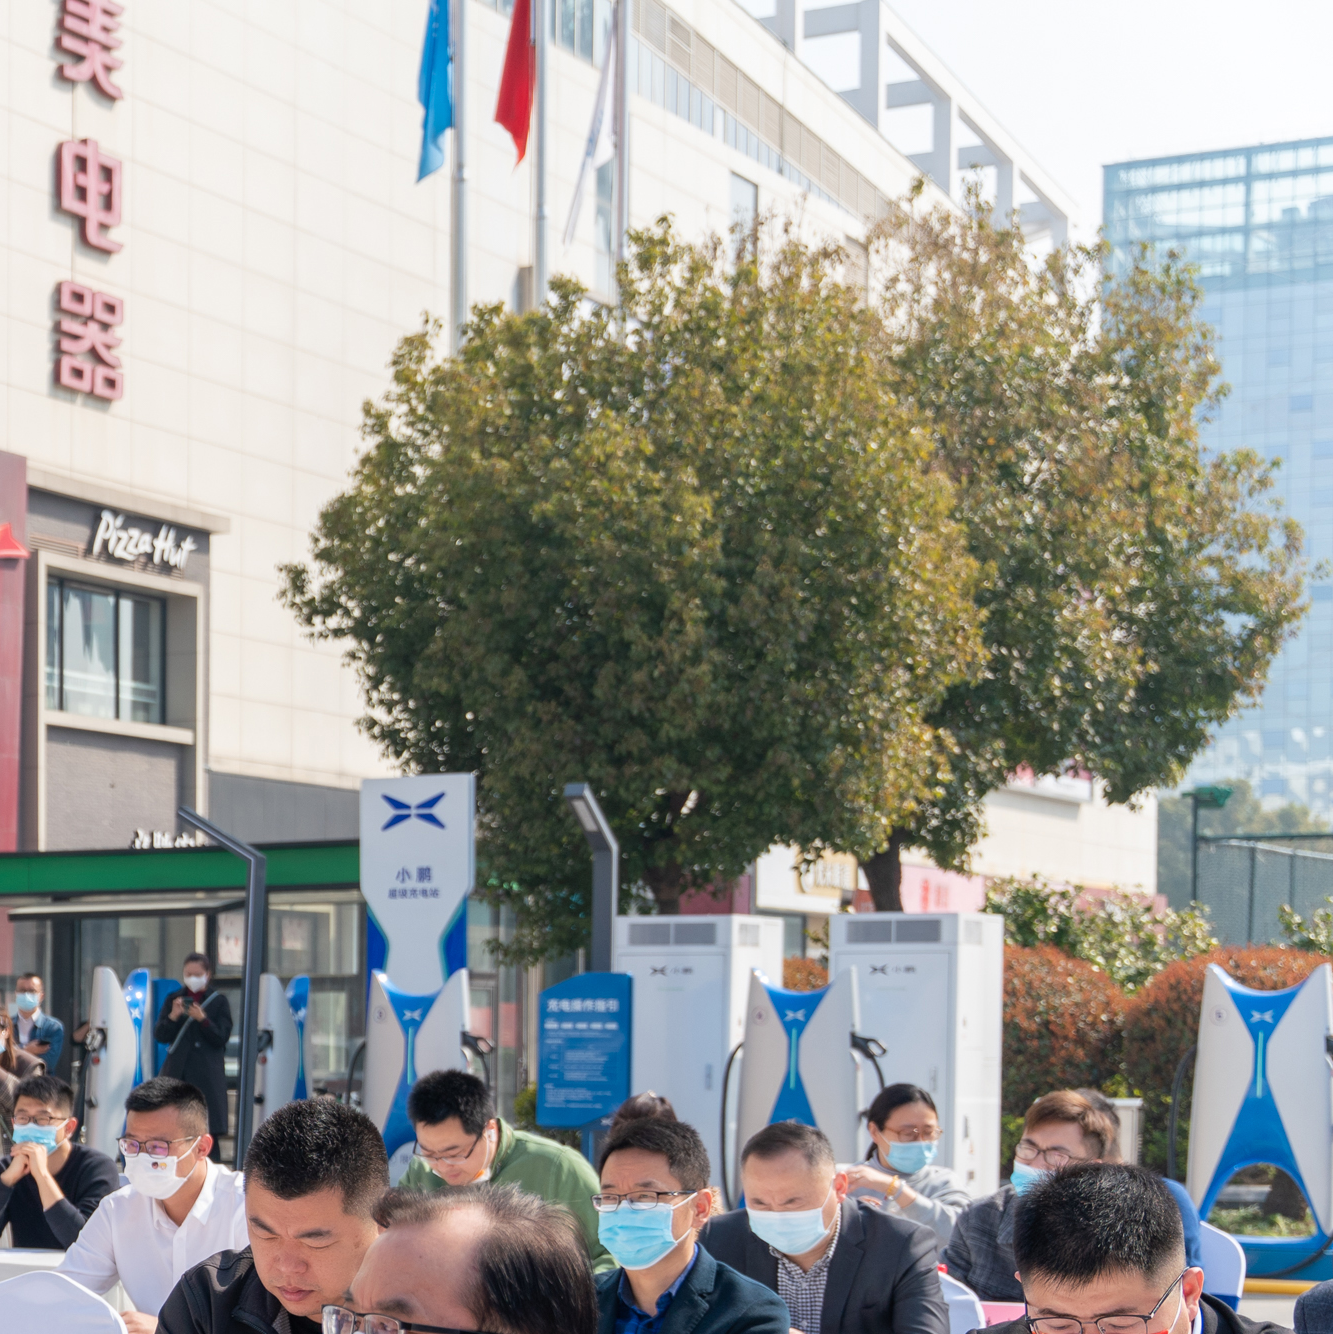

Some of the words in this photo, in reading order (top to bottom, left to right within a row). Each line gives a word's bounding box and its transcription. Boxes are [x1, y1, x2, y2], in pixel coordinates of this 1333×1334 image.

[93, 509, 154, 561] Pizza
[153, 524, 199, 570] Hut
[395, 866, 431, 883] 小鹏
[388, 887, 439, 899] 超级充电站
[546, 998, 620, 1013] 充电操作指引
